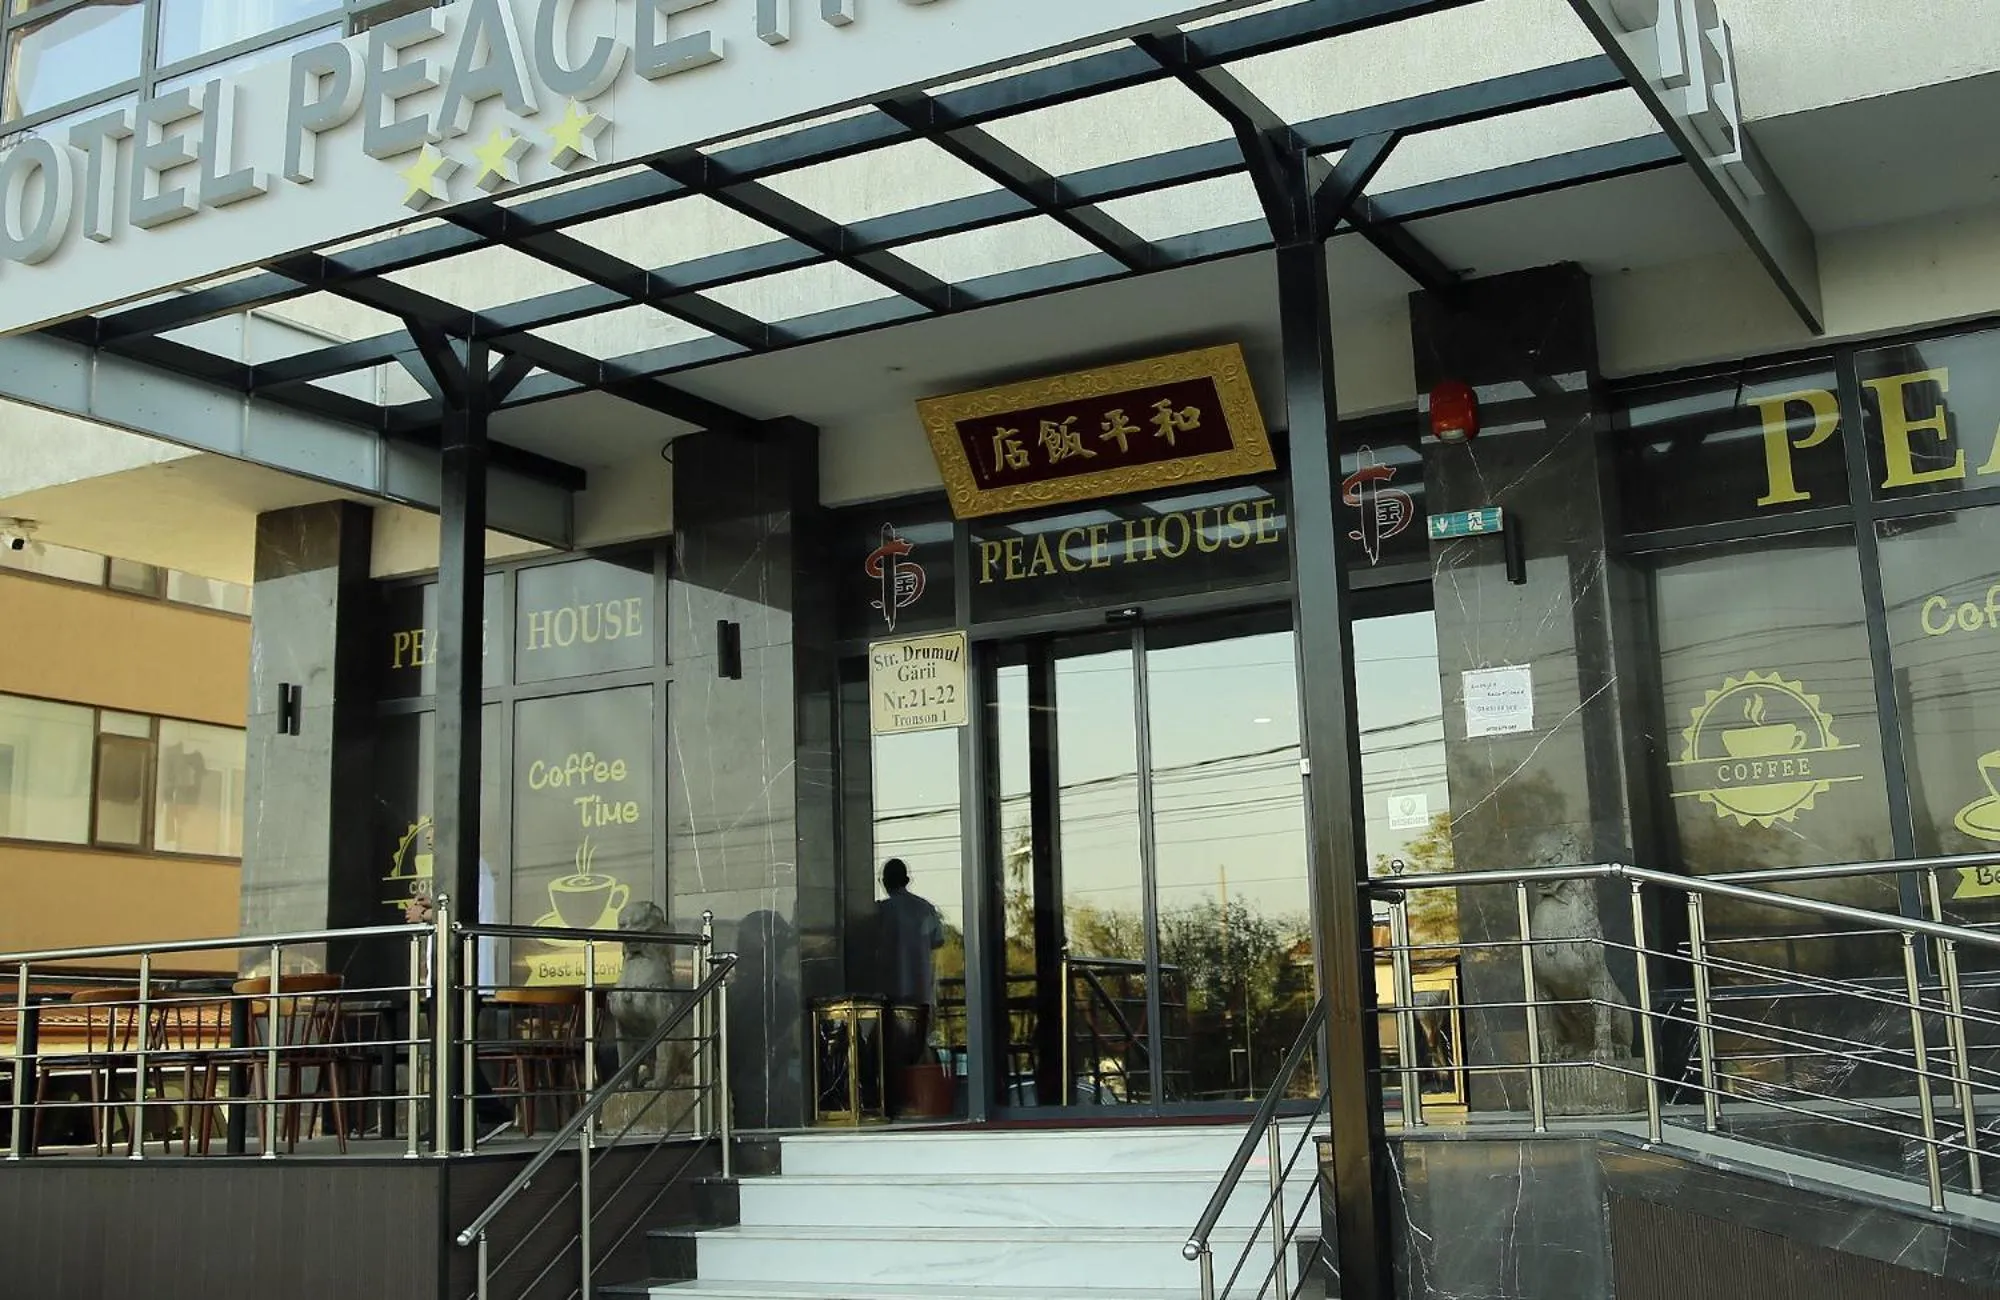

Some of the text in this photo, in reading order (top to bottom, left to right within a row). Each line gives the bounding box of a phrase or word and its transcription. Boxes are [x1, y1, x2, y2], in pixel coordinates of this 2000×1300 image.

[1746, 367, 2000, 506] PE
[979, 499, 1280, 584] PEACE HOUSE
[526, 597, 643, 651] HOUSE
[873, 645, 960, 672] Str. Drumul
[897, 662, 936, 682] Gării
[883, 684, 955, 712] Nr.21-22
[892, 713, 938, 727] Tronson
[529, 752, 628, 790] Coffee
[1718, 758, 1811, 782] COFFEE
[574, 795, 640, 828] Time
[539, 963, 573, 978] Best
